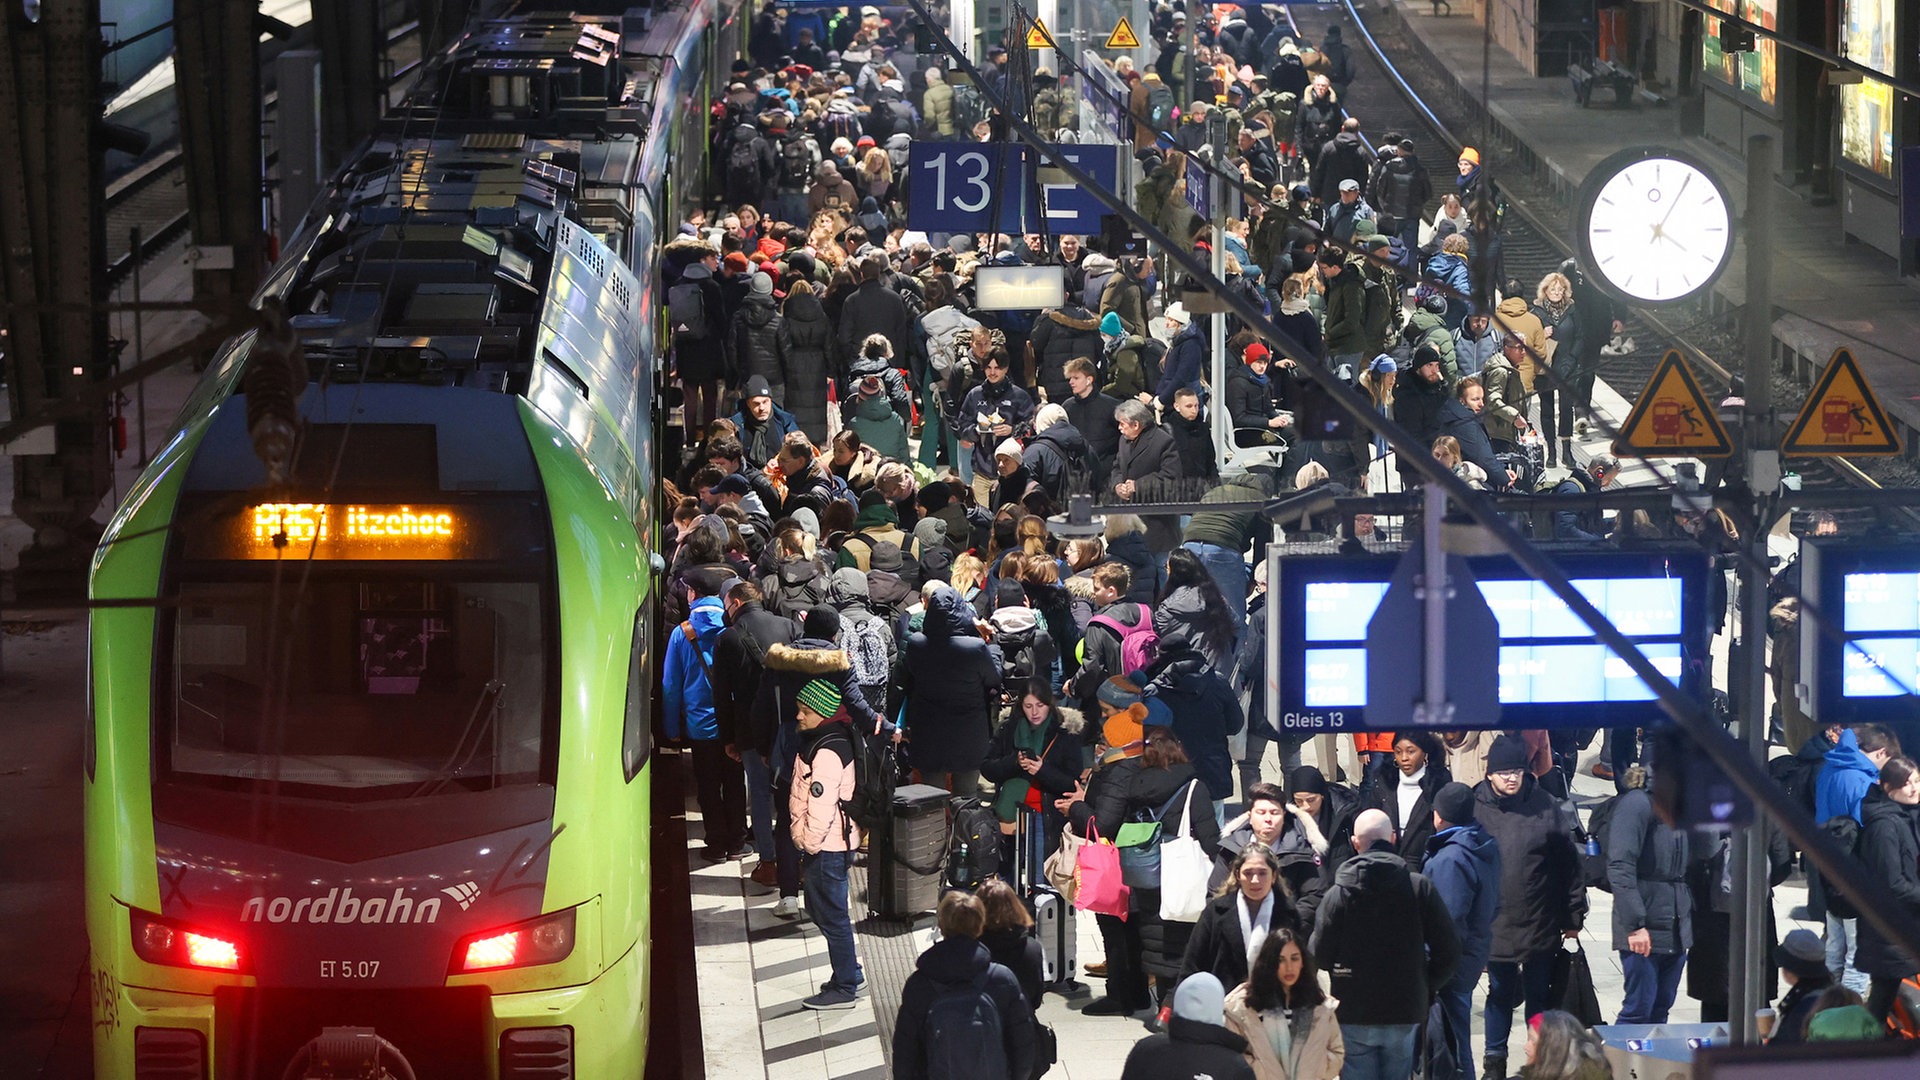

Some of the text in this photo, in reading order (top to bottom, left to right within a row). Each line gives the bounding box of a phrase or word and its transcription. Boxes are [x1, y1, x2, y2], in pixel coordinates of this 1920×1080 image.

[923, 151, 992, 213] 13
[1040, 155, 1079, 218] E
[1284, 711, 1344, 728] Gleis 13
[239, 887, 442, 924] nordbahn
[320, 960, 380, 978] ET 5.07
